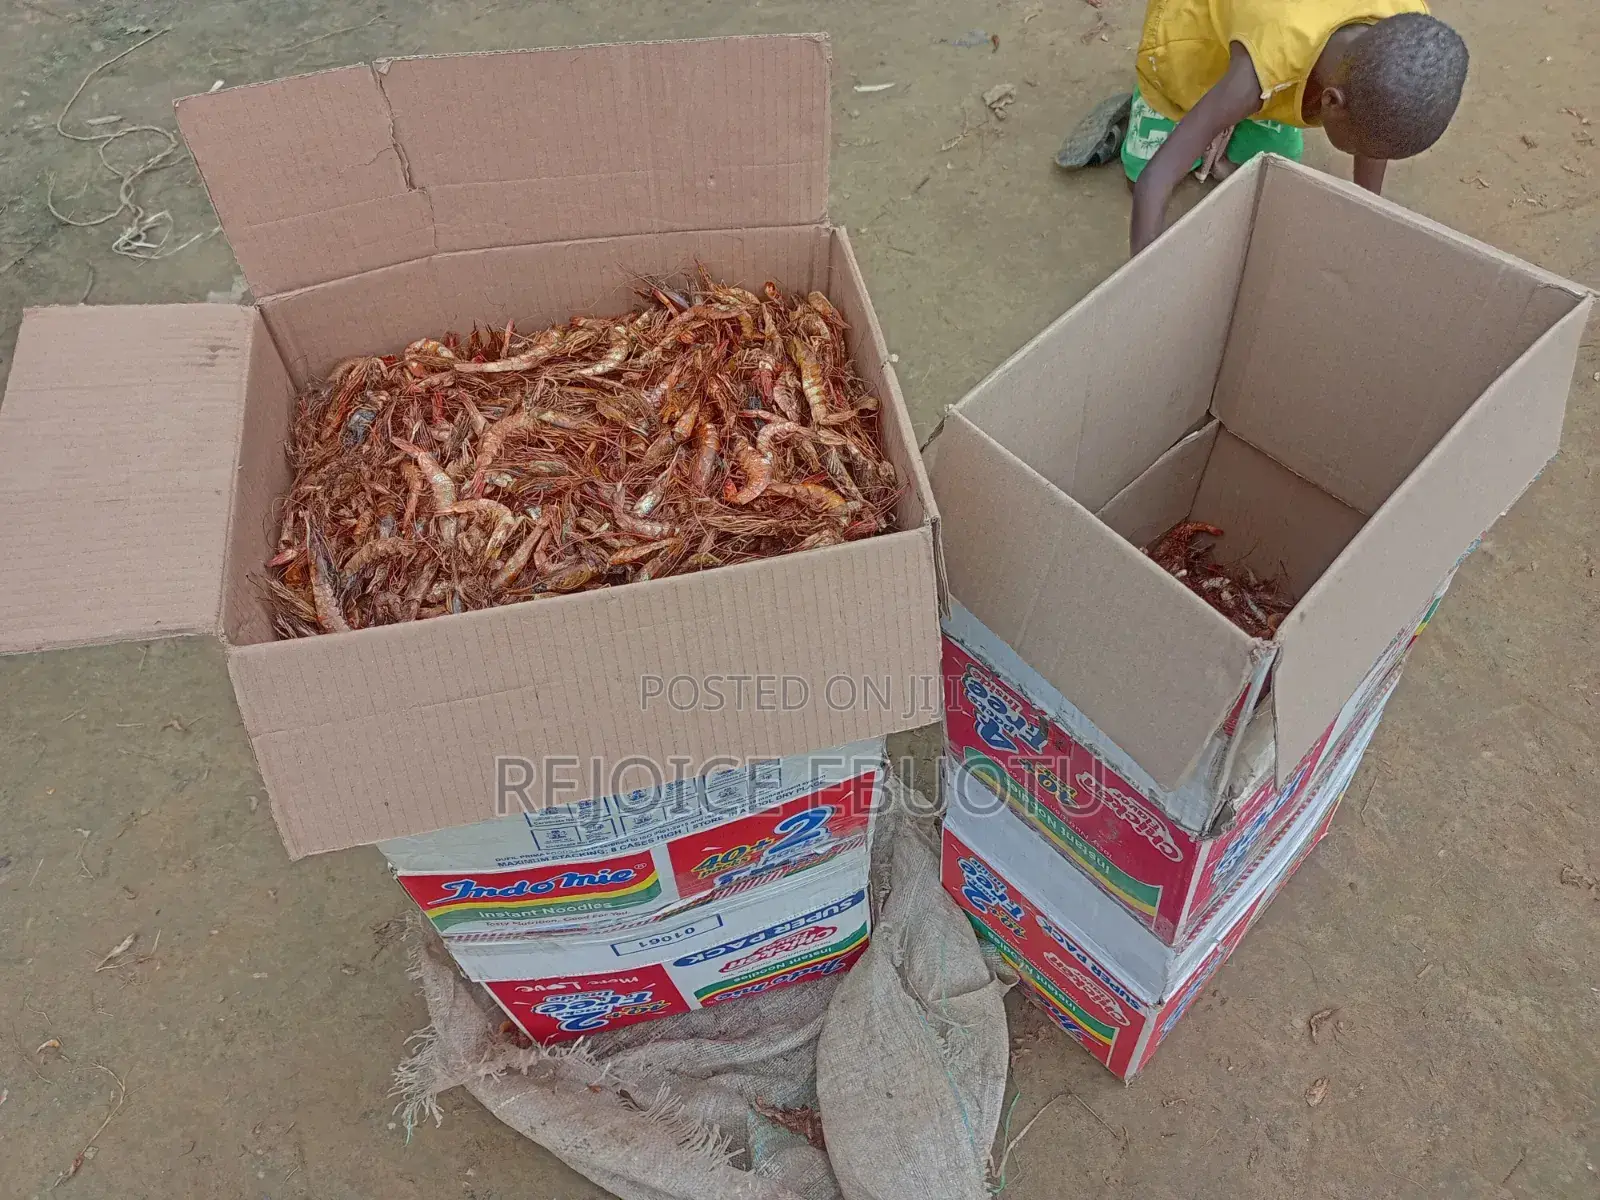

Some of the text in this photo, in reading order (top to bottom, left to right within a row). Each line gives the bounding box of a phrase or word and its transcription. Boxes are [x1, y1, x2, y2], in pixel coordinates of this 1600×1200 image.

[968, 666, 1022, 712] Inside
[964, 676, 1048, 753] Free
[975, 718, 1019, 753] 4
[497, 857, 548, 867] MAXIMUM
[619, 837, 654, 850] CASES
[656, 829, 681, 840] HIGH
[692, 815, 724, 828] STORE
[775, 790, 795, 800] DRY
[764, 805, 837, 856] 2
[1078, 772, 1182, 861] Chicken
[1059, 827, 1111, 875] Instant
[478, 902, 613, 918] Instant Noodles
[958, 858, 1024, 921] Free
[962, 880, 996, 914] 2
[638, 926, 697, 948] 01061
[687, 897, 854, 964] SUPER PACK
[720, 926, 837, 972] Chicken
[513, 981, 581, 992] Love
[733, 947, 832, 983] Instant Noodles
[1041, 924, 1141, 1010] SUPER PACK
[532, 992, 652, 1014] Free
[1035, 974, 1076, 1012] Instant
[1044, 952, 1130, 1026] Chicken
[558, 1010, 609, 1031] 2
